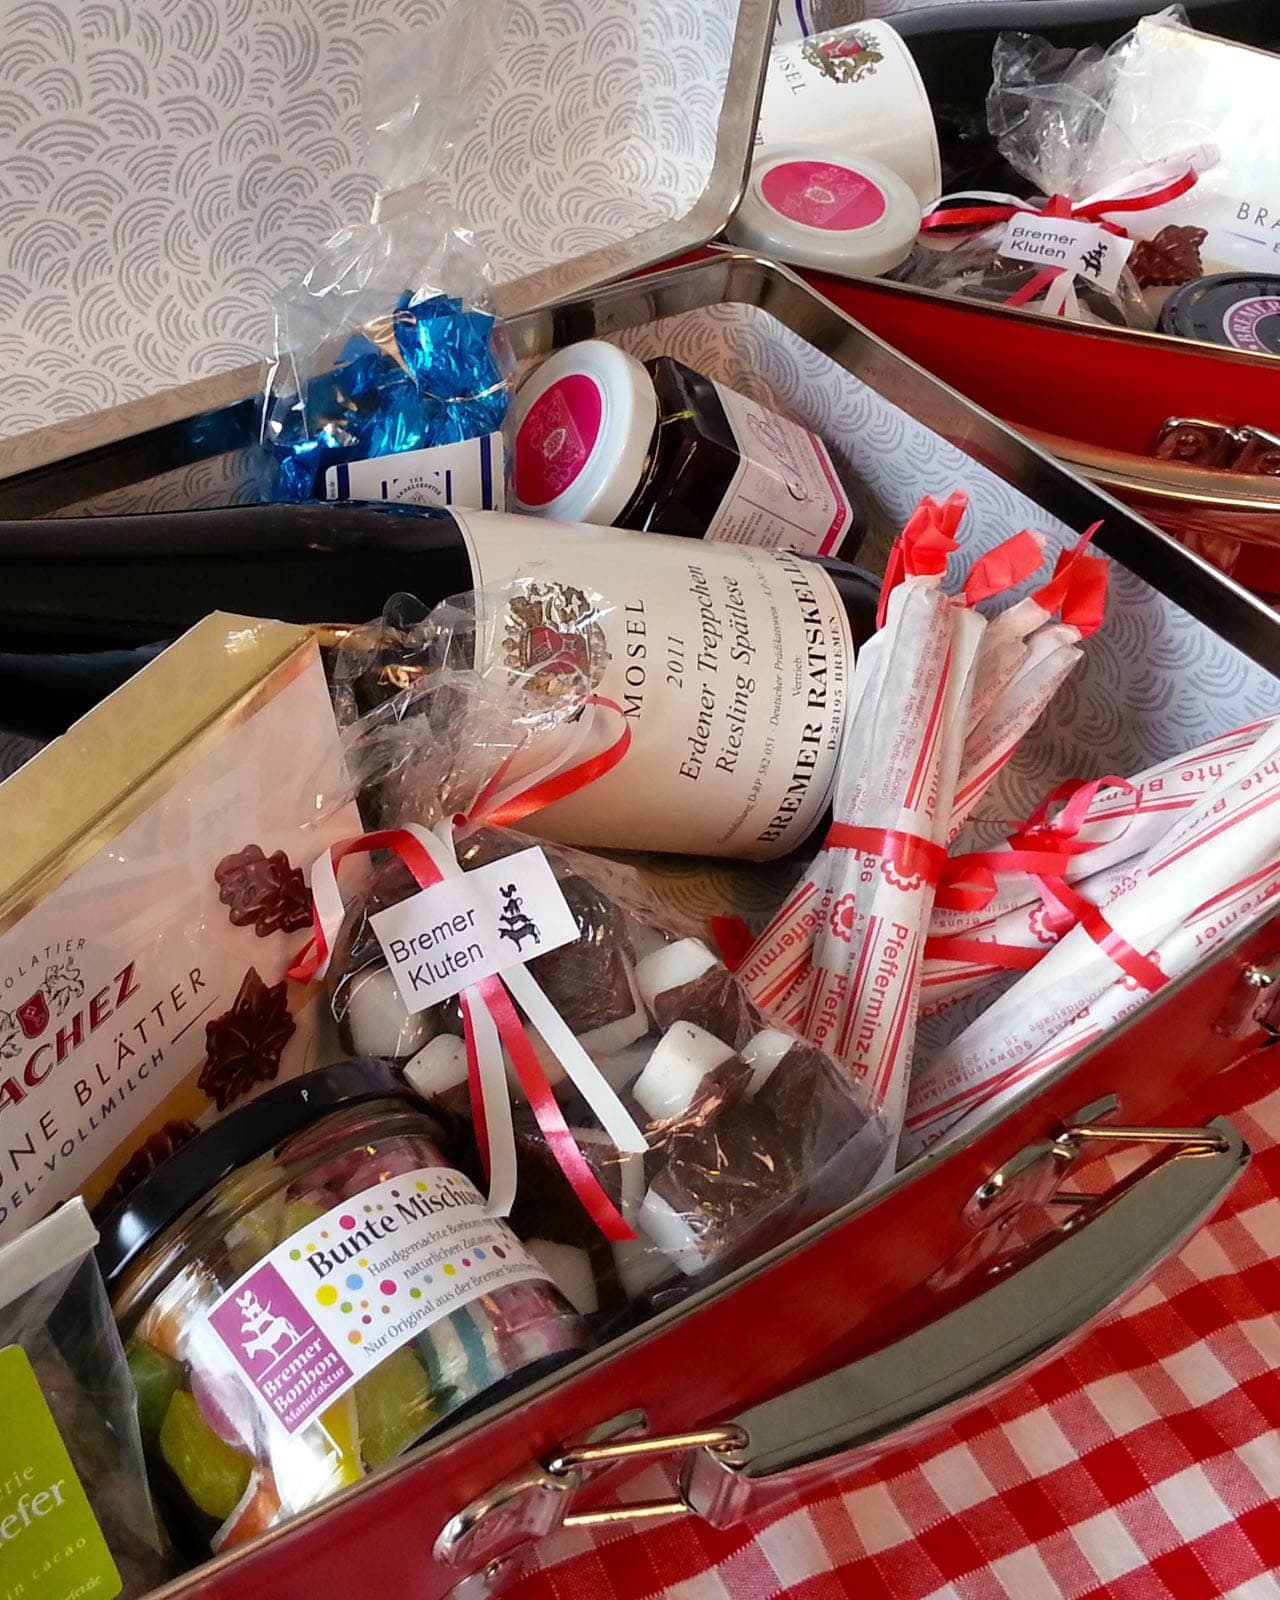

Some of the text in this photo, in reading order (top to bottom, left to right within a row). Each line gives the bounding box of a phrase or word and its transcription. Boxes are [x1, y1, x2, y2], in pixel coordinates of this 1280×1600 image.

[771, 46, 806, 96] OSEL
[1010, 240, 1067, 259] Kluten
[1011, 226, 1078, 246] Bremer
[722, 575, 757, 666] Spätlese
[623, 599, 648, 720] MOSEL
[666, 635, 685, 689] 2011
[679, 564, 723, 782] Erdener Treppchen
[826, 615, 844, 751] D-28195 BREMEN
[715, 674, 756, 775] Riesling
[756, 722, 824, 843] BREMER
[389, 907, 476, 964] Bremer
[408, 943, 484, 992] Kluten
[0, 960, 142, 1114] ACHEZ
[73, 967, 206, 1107] BLÄTTER
[306, 1213, 399, 1280] Bunte
[367, 1228, 448, 1278] Handgemachte
[362, 1330, 388, 1357] Nur
[387, 1299, 437, 1345] Original
[435, 1290, 455, 1310] aus
[454, 1274, 474, 1297] der
[262, 1336, 323, 1398] Bremer
[273, 1351, 339, 1413] Bonbon
[284, 1364, 346, 1426] Manufaktur
[0, 1465, 36, 1498] rie
[0, 1478, 65, 1549] efer
